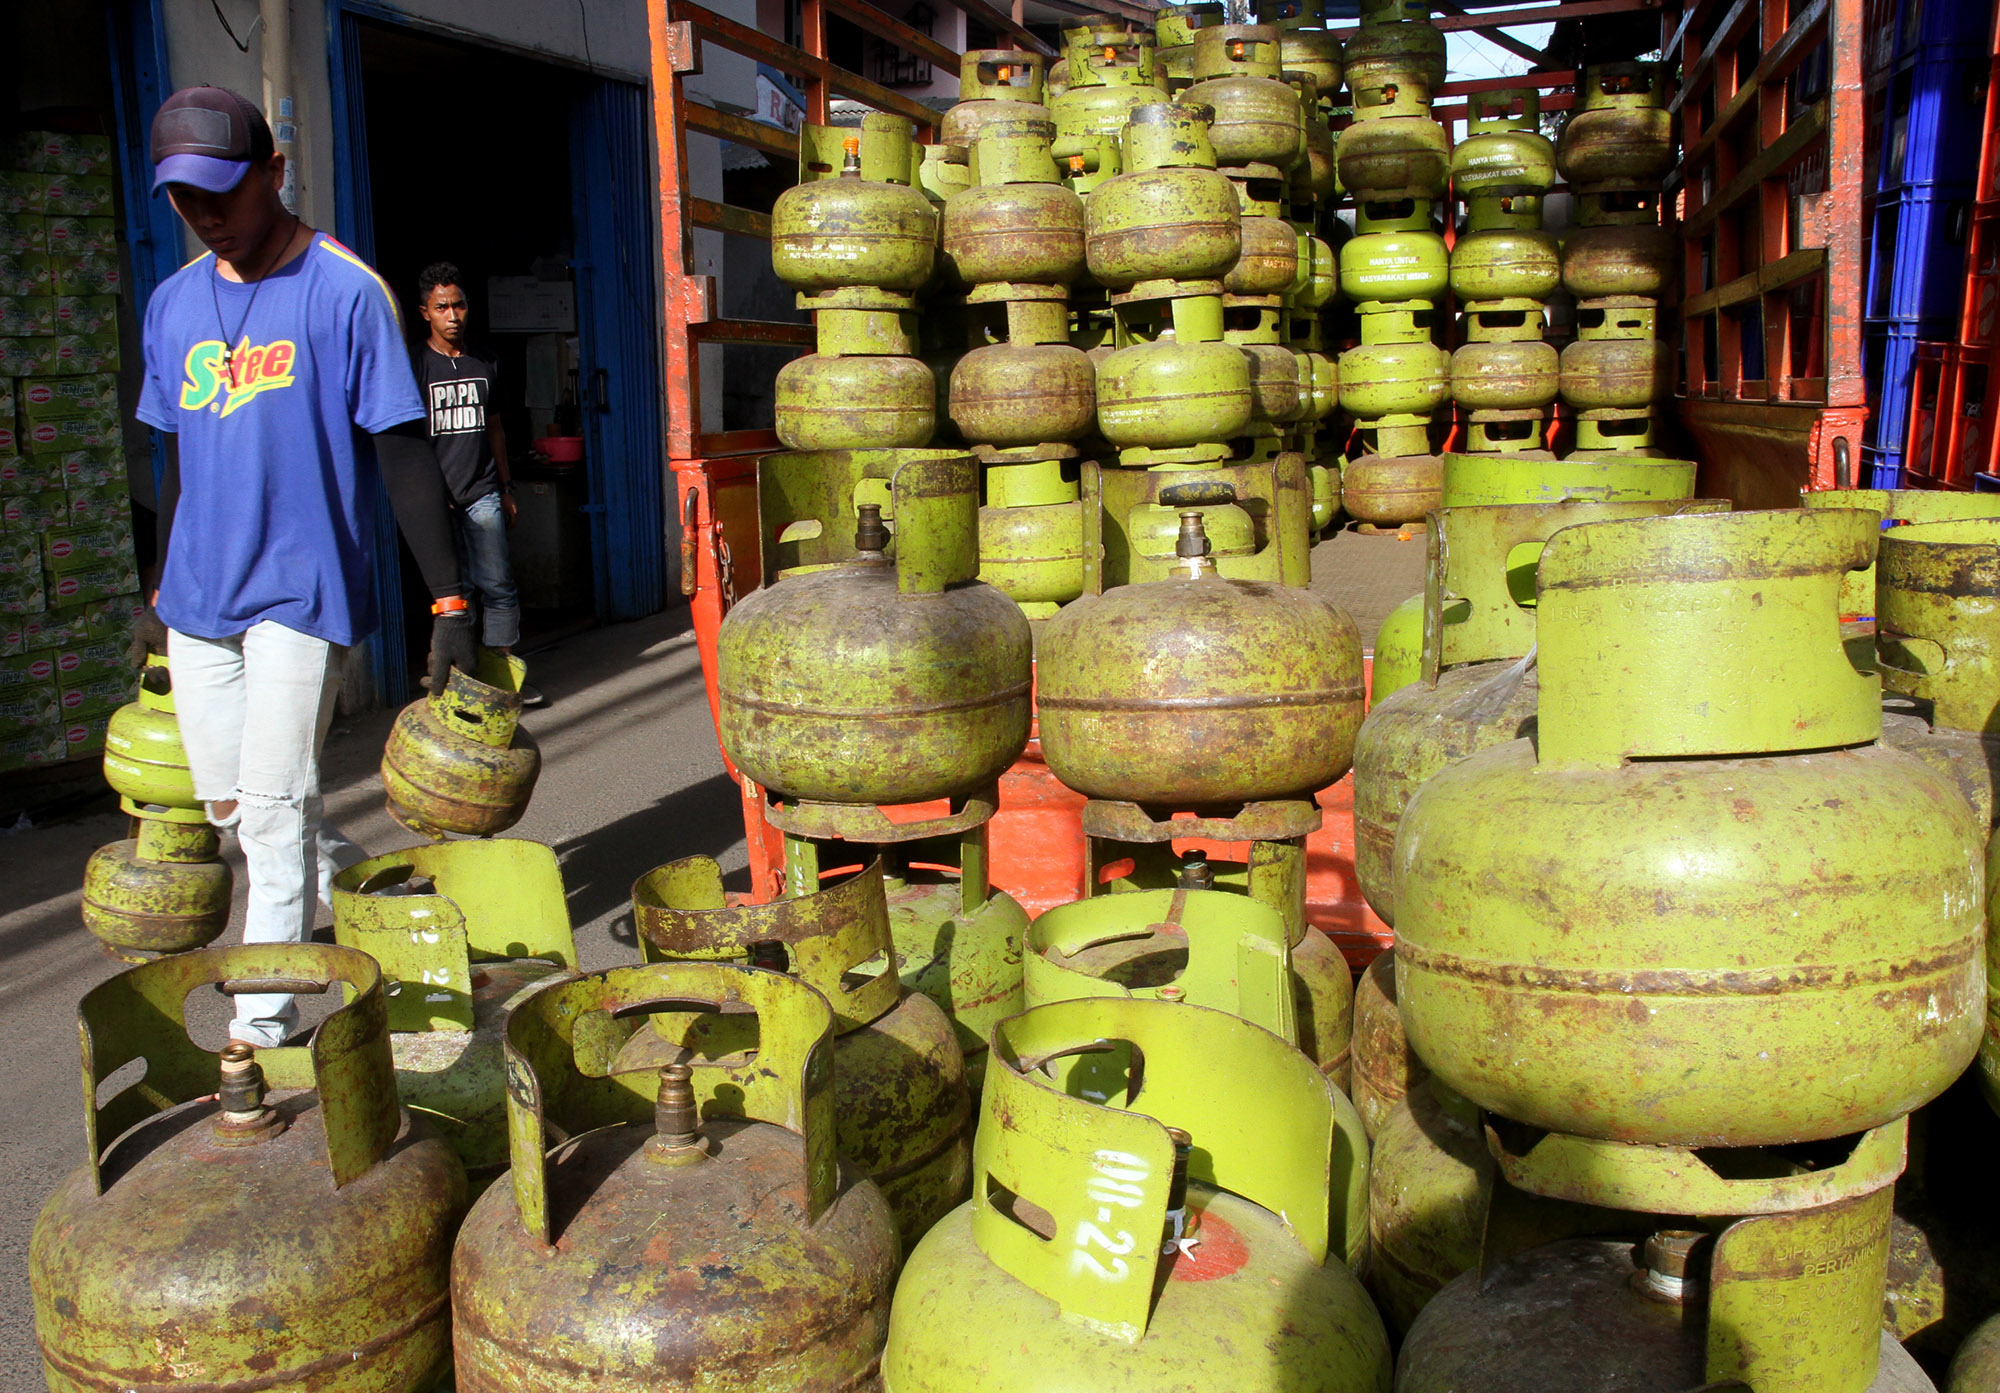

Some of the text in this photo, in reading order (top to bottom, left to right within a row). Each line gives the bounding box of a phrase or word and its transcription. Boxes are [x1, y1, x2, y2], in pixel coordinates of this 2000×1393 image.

[1468, 154, 1513, 166] HANYA UNTUK
[1461, 170, 1500, 182] MASYARAKAT
[1369, 257, 1394, 266] HANYA
[1360, 272, 1405, 283] MASYARAKAT
[433, 383, 479, 409] PAPA
[435, 405, 485, 431] MUDA
